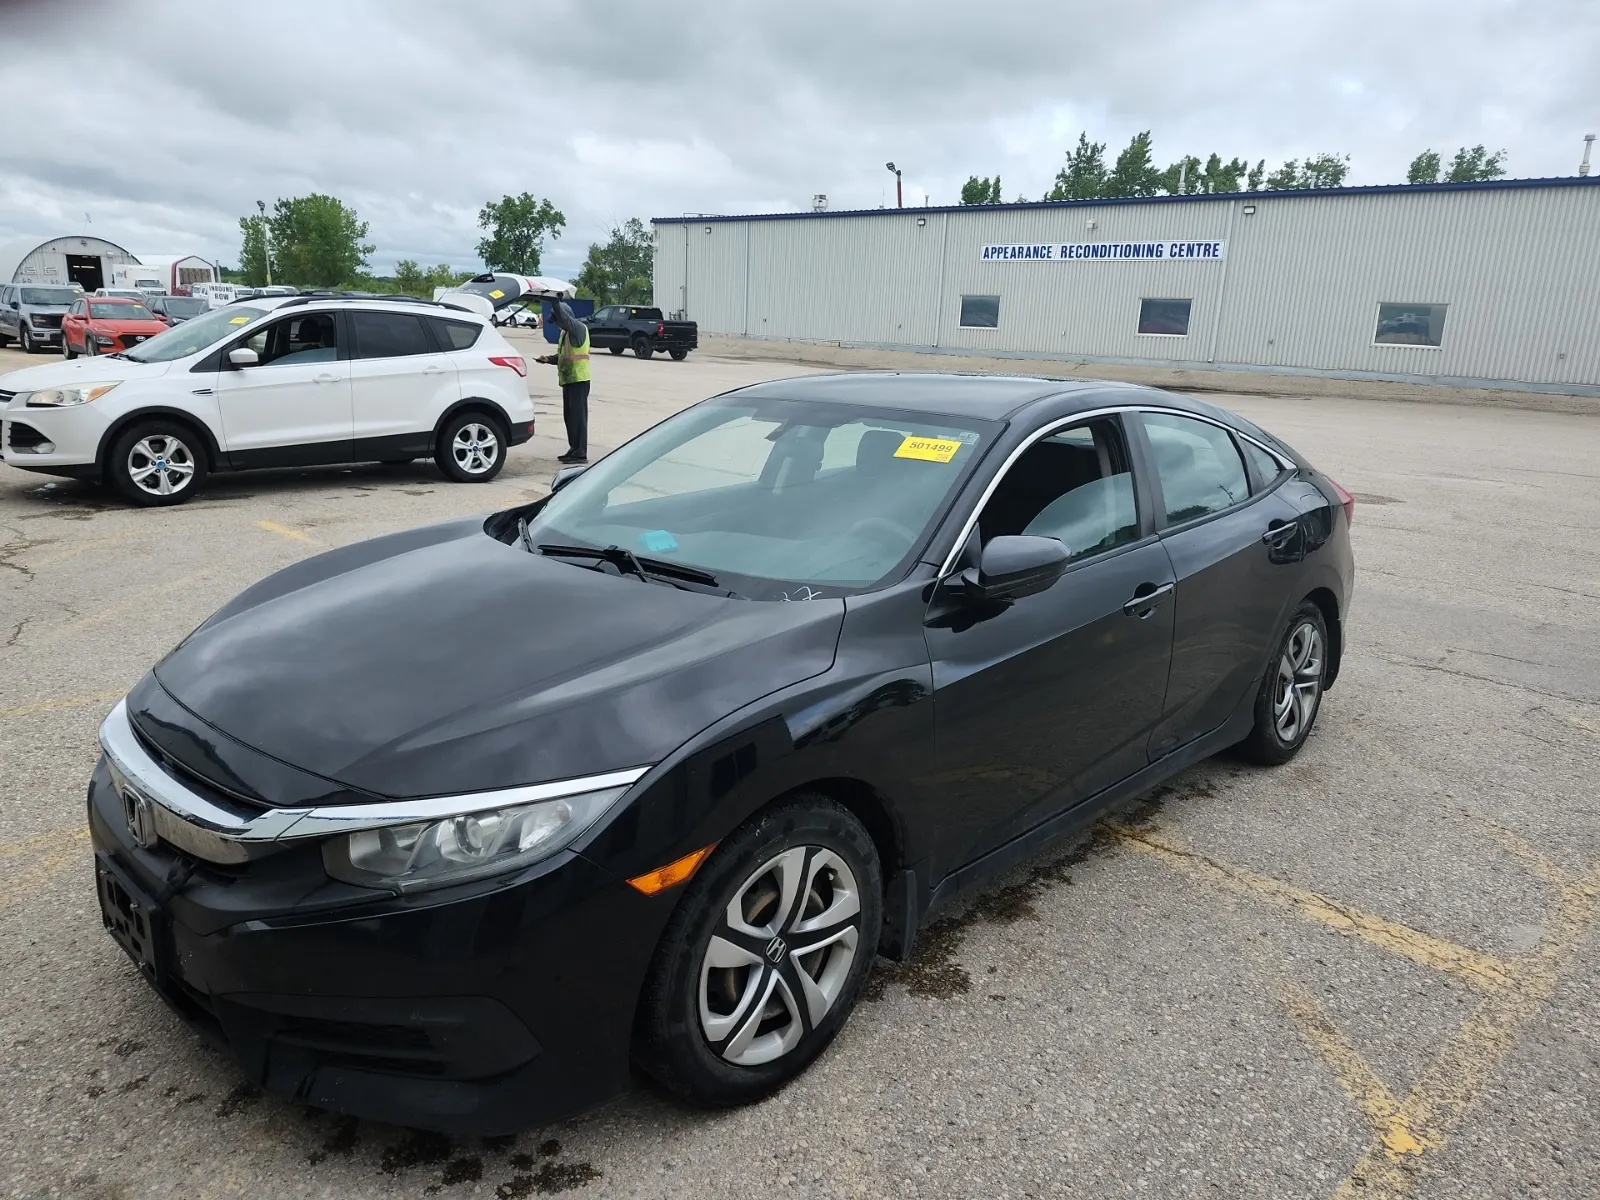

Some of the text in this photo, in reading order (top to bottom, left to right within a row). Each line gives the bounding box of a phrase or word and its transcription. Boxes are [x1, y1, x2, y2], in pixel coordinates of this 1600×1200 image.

[983, 242, 1220, 260] APPEARANCE RECONDITIONING CENTRE
[909, 441, 953, 453] 501499
